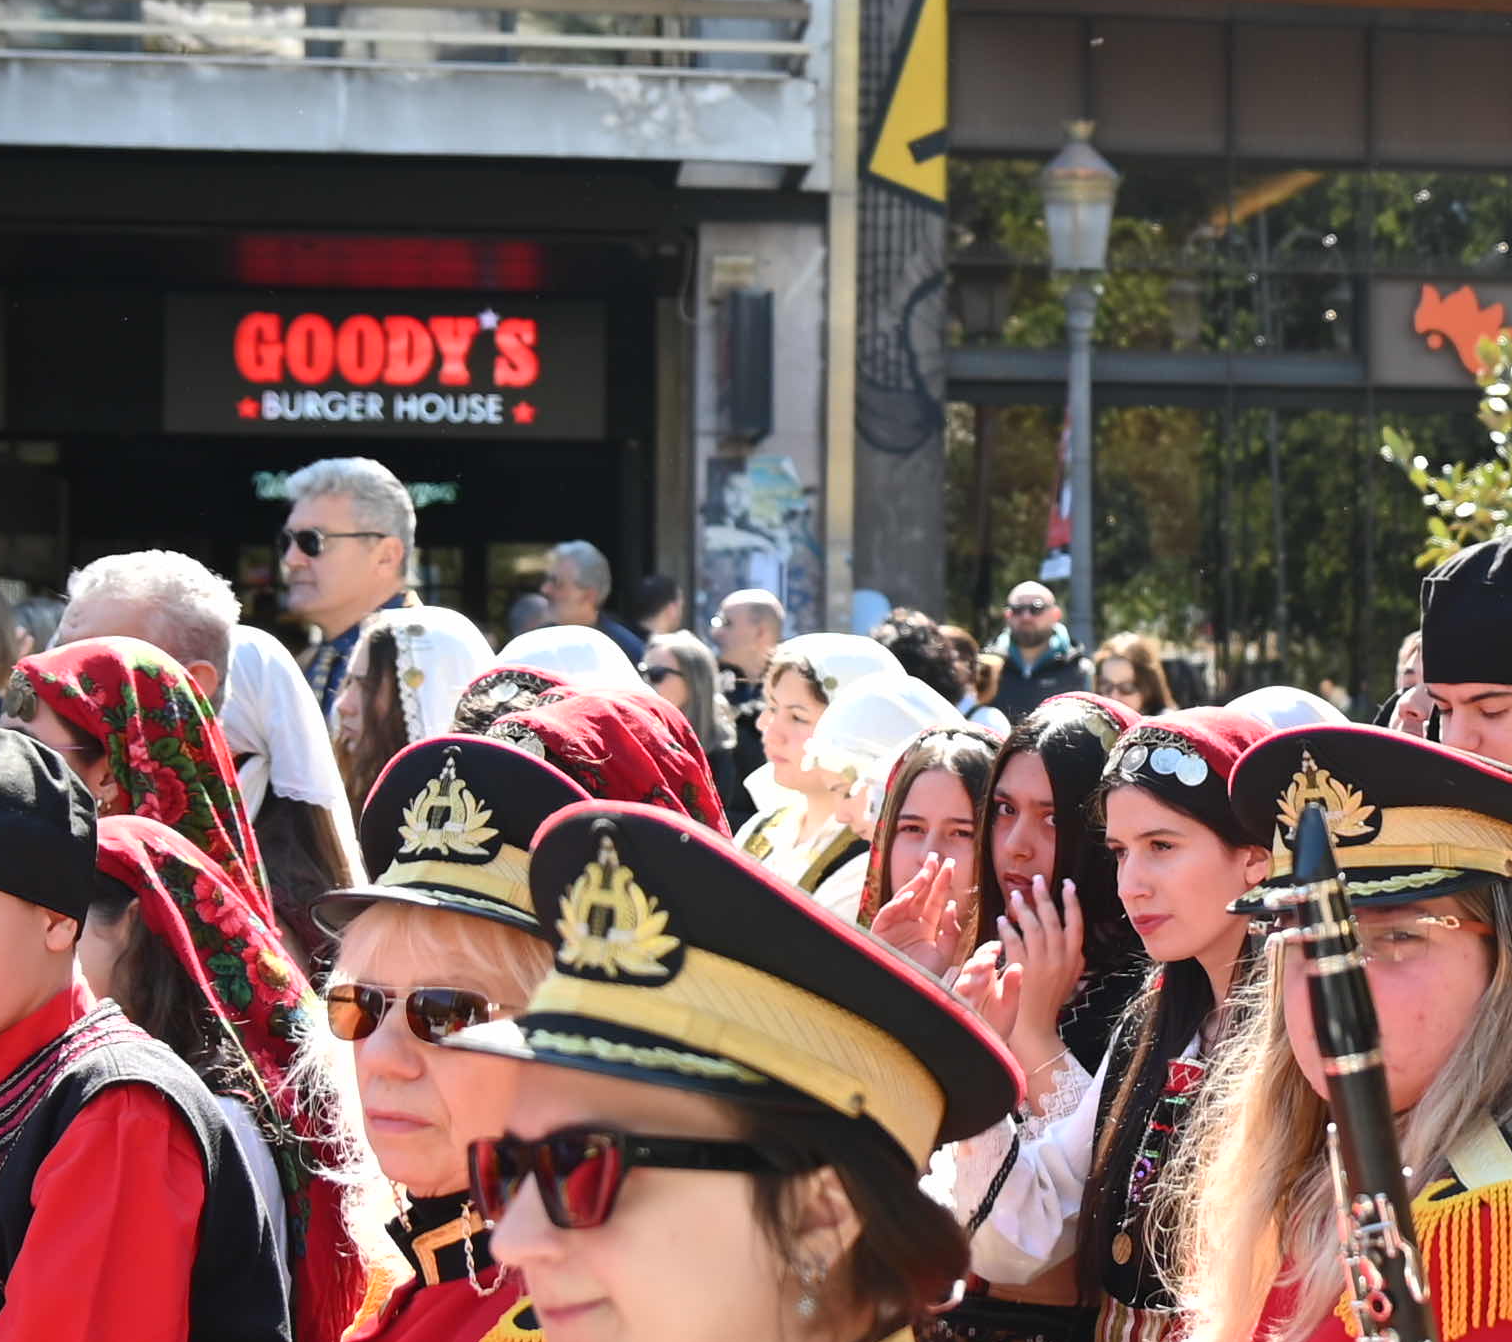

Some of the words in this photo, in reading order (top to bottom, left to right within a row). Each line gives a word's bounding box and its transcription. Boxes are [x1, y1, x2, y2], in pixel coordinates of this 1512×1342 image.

[234, 309, 540, 388] GOODY'S
[260, 390, 385, 421] BURGER
[393, 393, 504, 425] HOUSE
